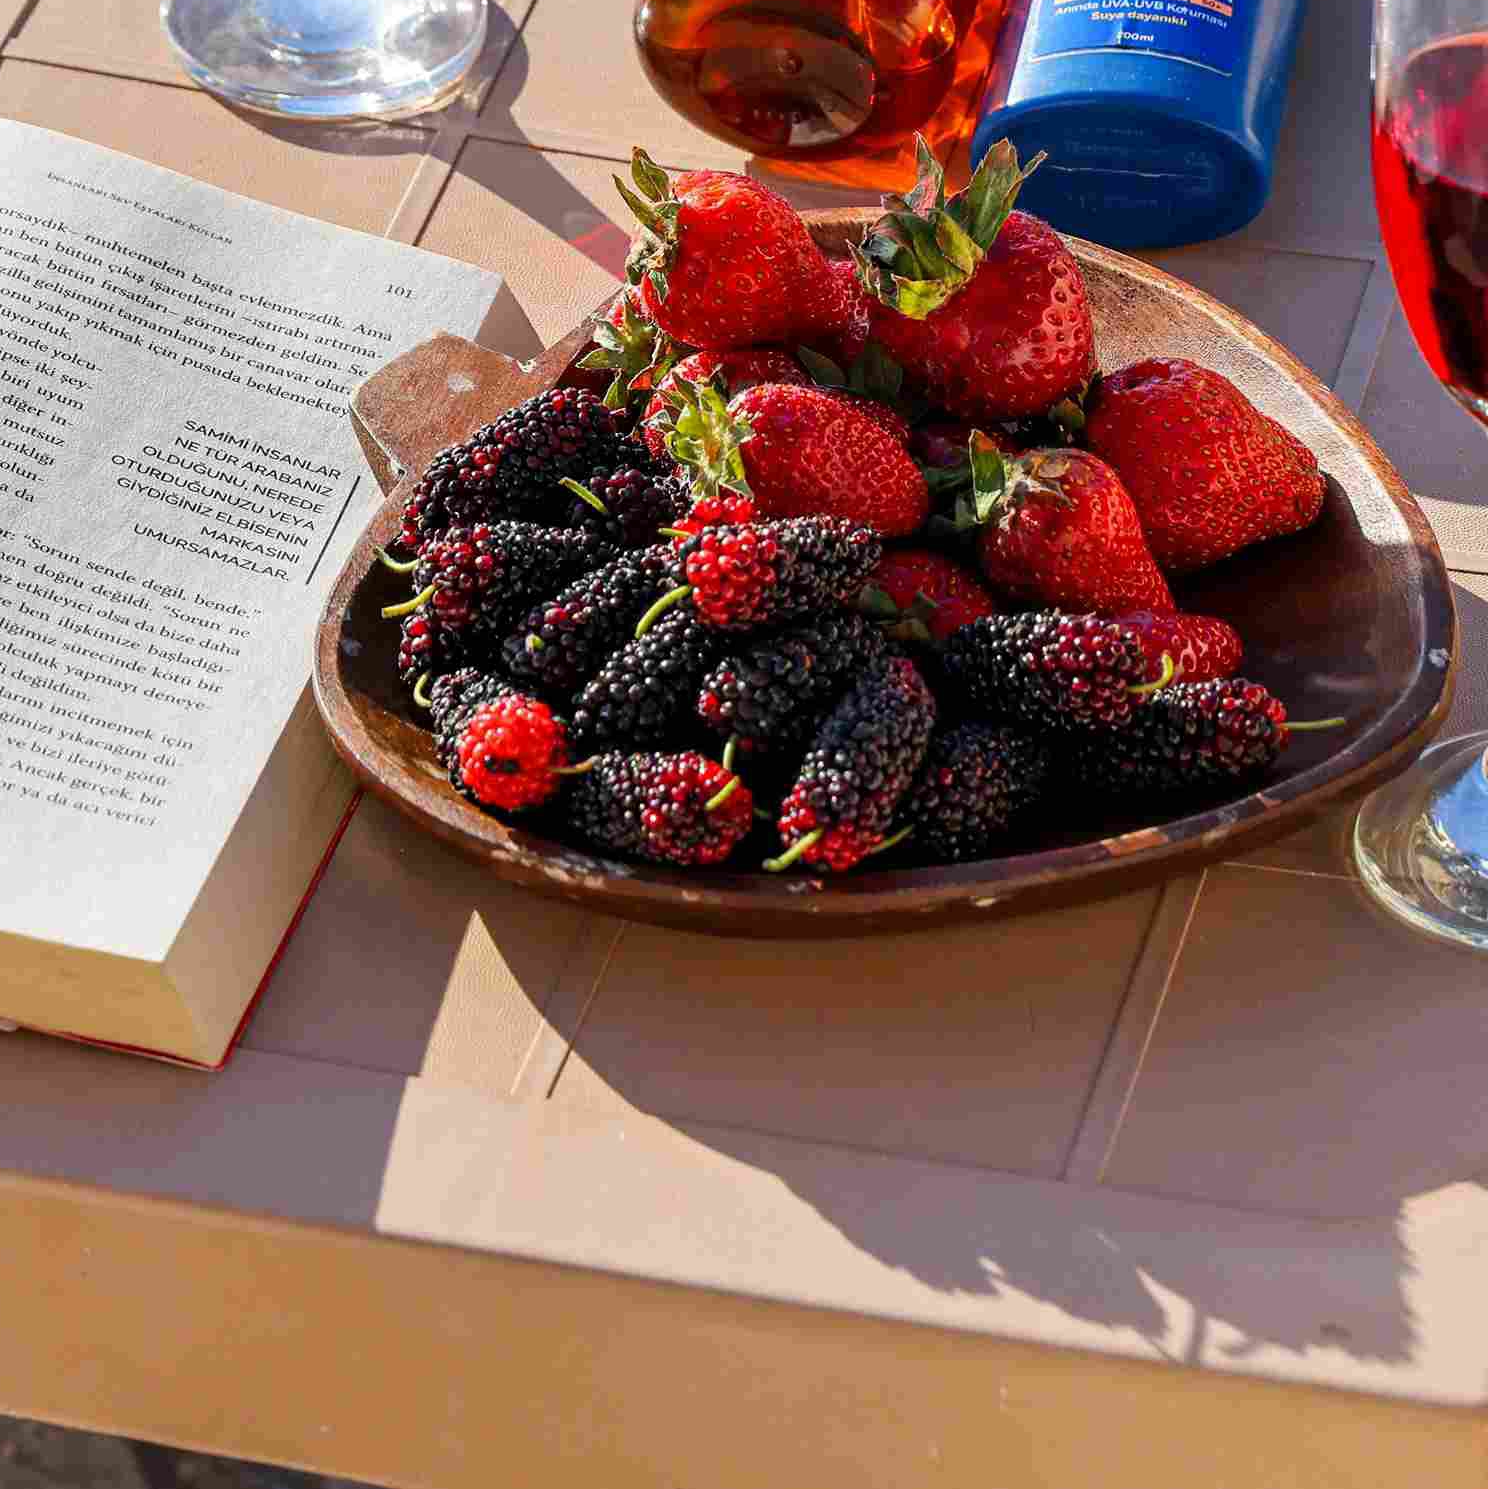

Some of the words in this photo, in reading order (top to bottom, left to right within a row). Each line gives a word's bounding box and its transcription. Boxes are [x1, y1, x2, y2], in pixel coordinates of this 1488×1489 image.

[17, 229, 50, 248] ben
[52, 241, 103, 267] bütün
[104, 262, 146, 286] çıkış
[148, 276, 238, 318] işaretlerini
[312, 335, 385, 359] artırma-
[82, 233, 187, 279] muhtemelen
[190, 272, 234, 297] başta
[237, 292, 344, 330] evlenmezdik.
[351, 322, 395, 342] Ama
[384, 282, 416, 301] 101
[34, 299, 81, 325] yakıp
[80, 317, 146, 347] yıkmak
[146, 339, 182, 362] için
[179, 356, 242, 383] pusuda
[0, 369, 35, 390] biri
[35, 385, 87, 411] uyum
[174, 436, 201, 453] NE
[204, 444, 240, 467] TÜR
[241, 459, 336, 498] ARABANIZ
[184, 419, 250, 450] SAMİMİ
[250, 438, 342, 481] İNSANLAR
[111, 454, 265, 515] OTURDUĞUNUZU
[269, 508, 316, 532] VEYA
[116, 475, 213, 518] GİYDİĞİNİZ
[215, 511, 310, 548] ELBİSENİN
[252, 482, 326, 514] NEREDE
[84, 560, 137, 584] sende
[133, 522, 290, 582] UMURSAMAZLAR.
[200, 525, 301, 564] MARKASINI
[88, 580, 152, 611] değildi.
[227, 625, 251, 638] ne
[62, 664, 138, 695] yapmayı
